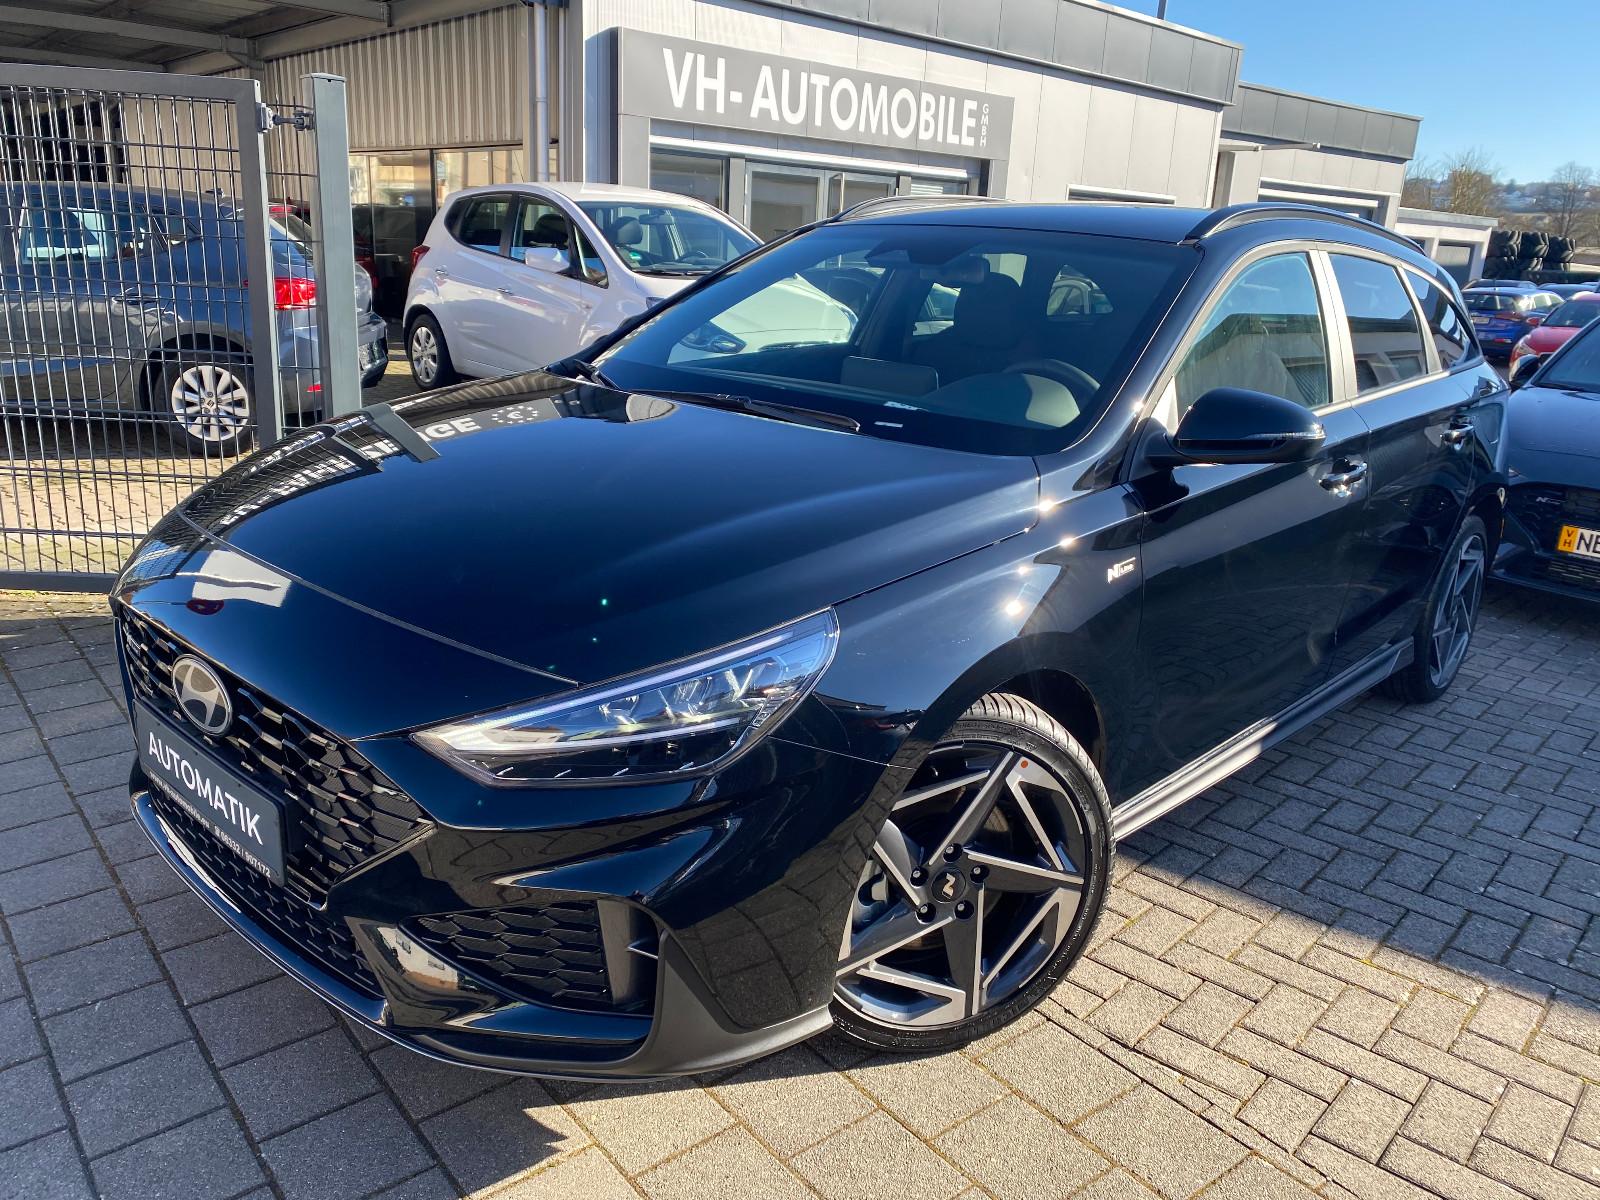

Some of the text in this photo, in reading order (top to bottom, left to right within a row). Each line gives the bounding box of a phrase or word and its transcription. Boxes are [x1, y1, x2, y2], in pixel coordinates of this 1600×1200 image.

[663, 48, 978, 147] VH- AUTOMOBILE
[148, 731, 264, 846] AUTOMATIK
